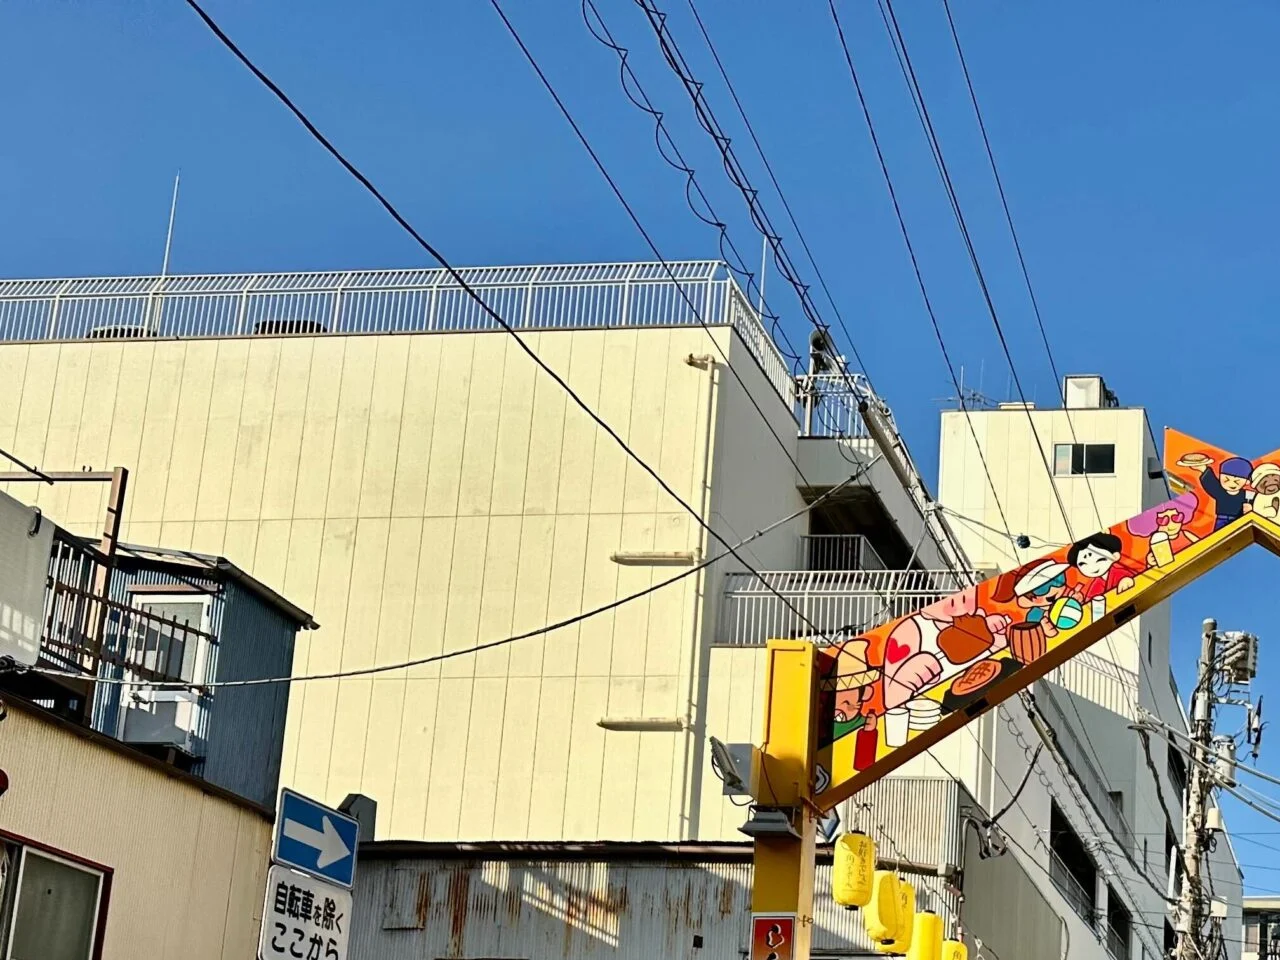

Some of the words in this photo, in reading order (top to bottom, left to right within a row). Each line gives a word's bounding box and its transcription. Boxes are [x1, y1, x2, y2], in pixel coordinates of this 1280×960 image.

[274, 881, 344, 934] 自転車を除く
